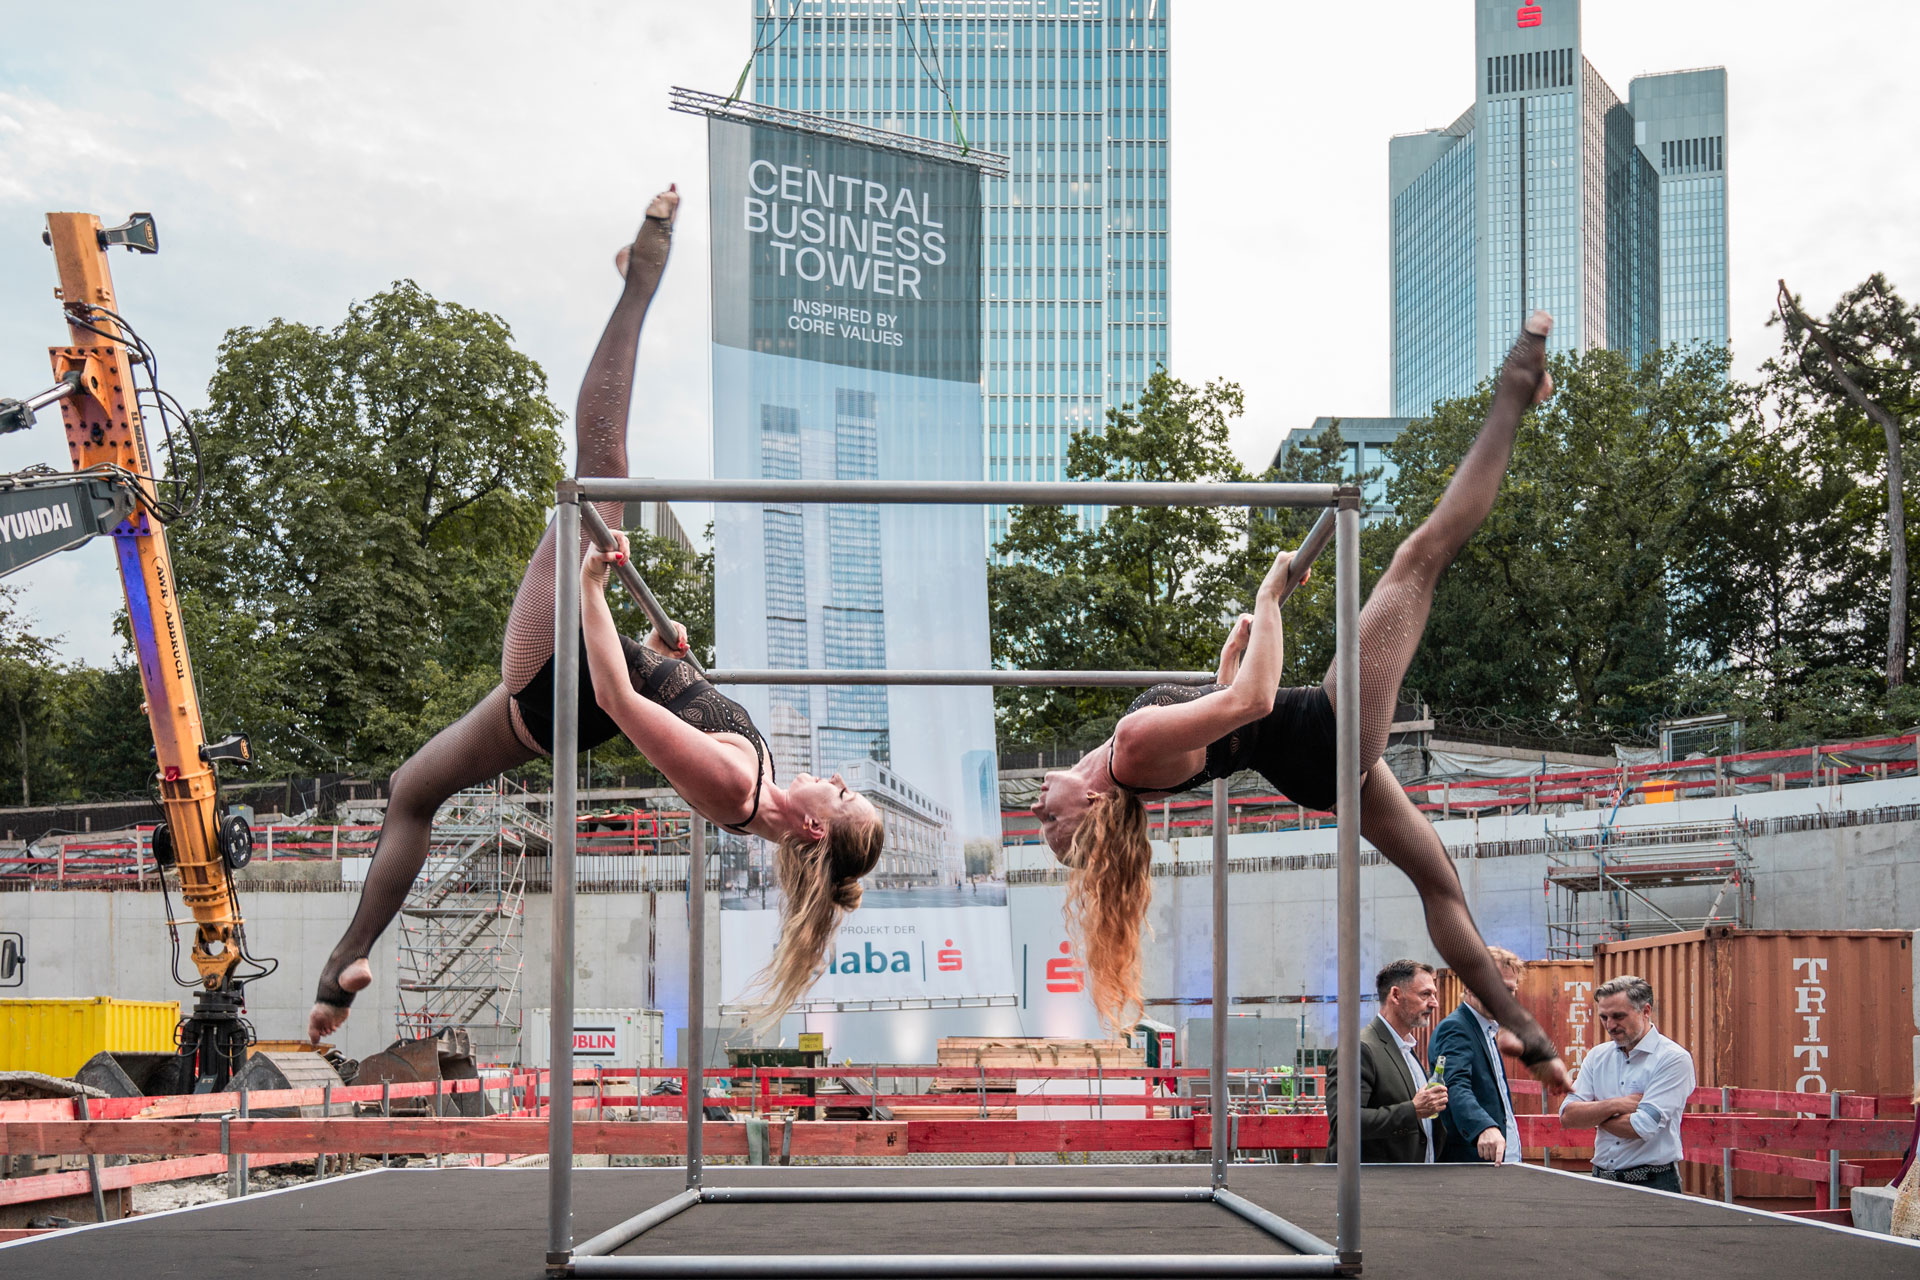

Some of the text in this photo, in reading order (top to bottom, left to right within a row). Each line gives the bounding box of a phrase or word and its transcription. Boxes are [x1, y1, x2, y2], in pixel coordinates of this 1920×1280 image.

[748, 159, 944, 229] CENTRAL
[744, 196, 947, 266] BUSINESS
[769, 240, 922, 300] TOWER
[788, 315, 904, 347] CORE VALUES
[793, 298, 898, 329] INSPIRED BY
[0, 502, 72, 543] YUNDAI
[156, 565, 185, 680] AWR ABBRUCH
[840, 925, 916, 935] PROJEKT DER
[1793, 958, 1828, 1119] TRITO
